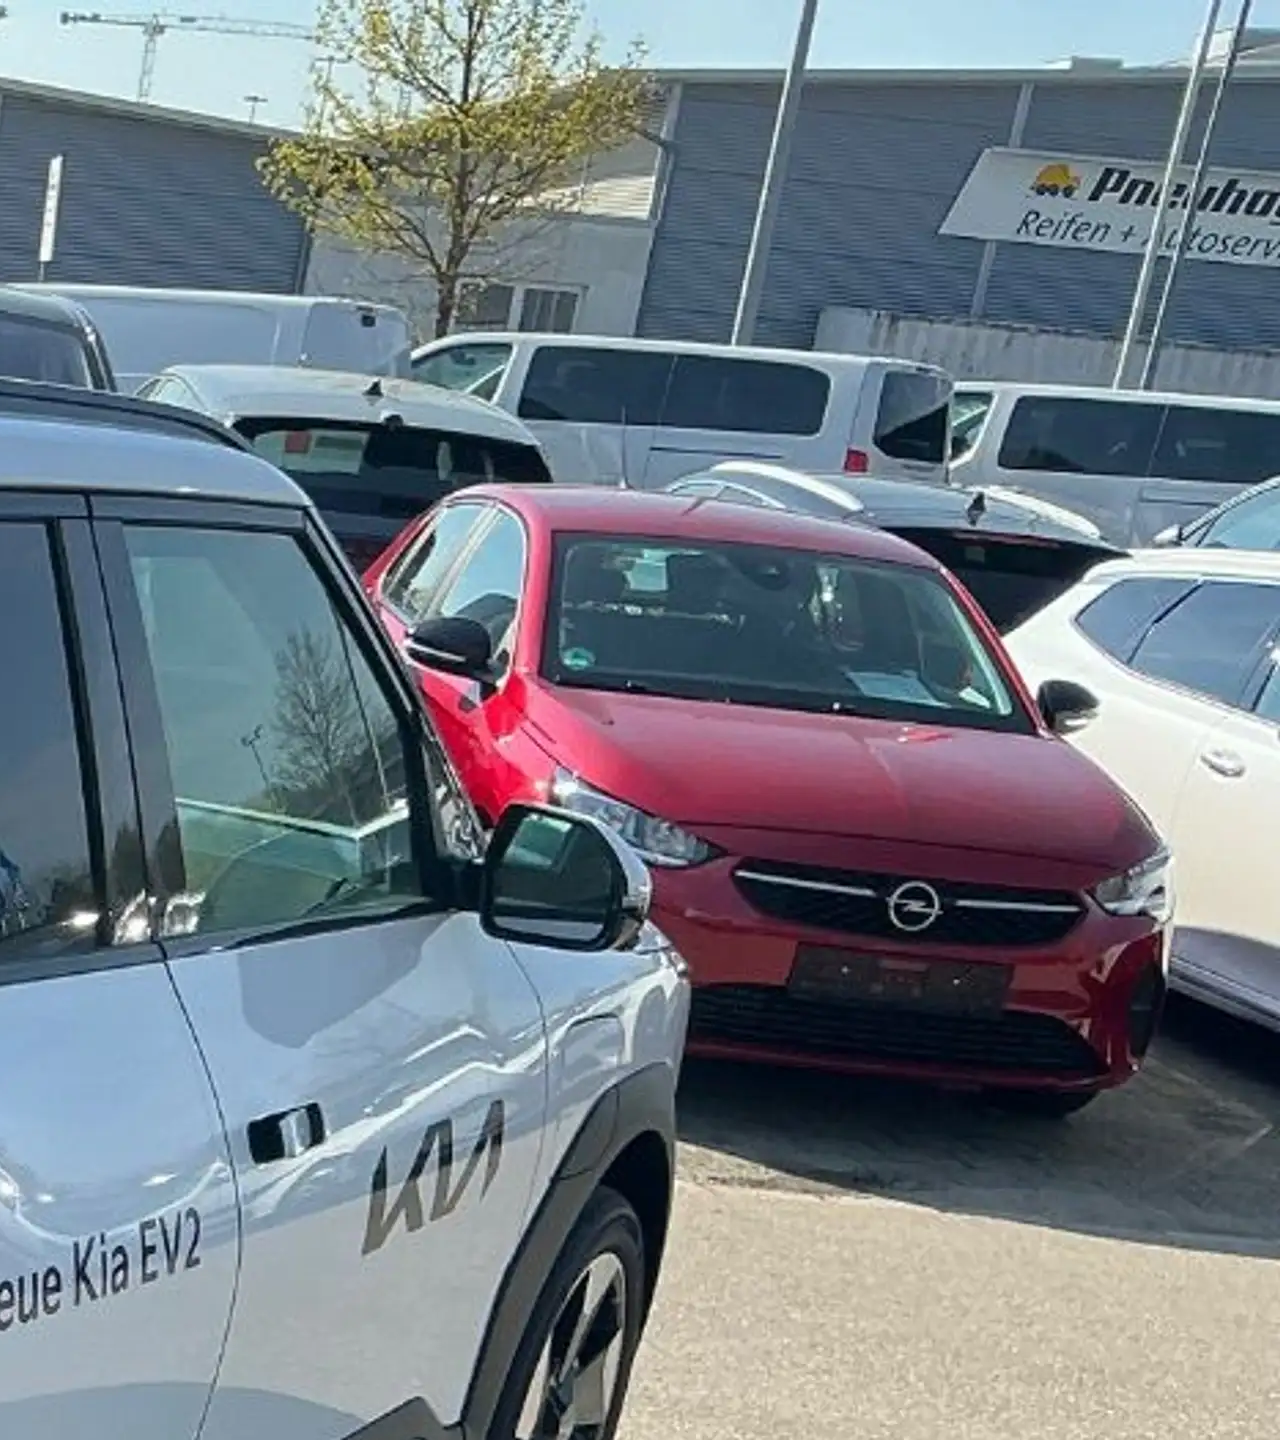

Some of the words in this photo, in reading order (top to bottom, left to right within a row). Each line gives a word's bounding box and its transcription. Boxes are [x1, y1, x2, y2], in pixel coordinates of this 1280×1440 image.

[1016, 209, 1112, 243] Reifen
[1120, 224, 1137, 242] +
[1142, 222, 1280, 259] utoserv
[72, 1230, 130, 1309] Kia
[139, 1207, 202, 1285] EV2
